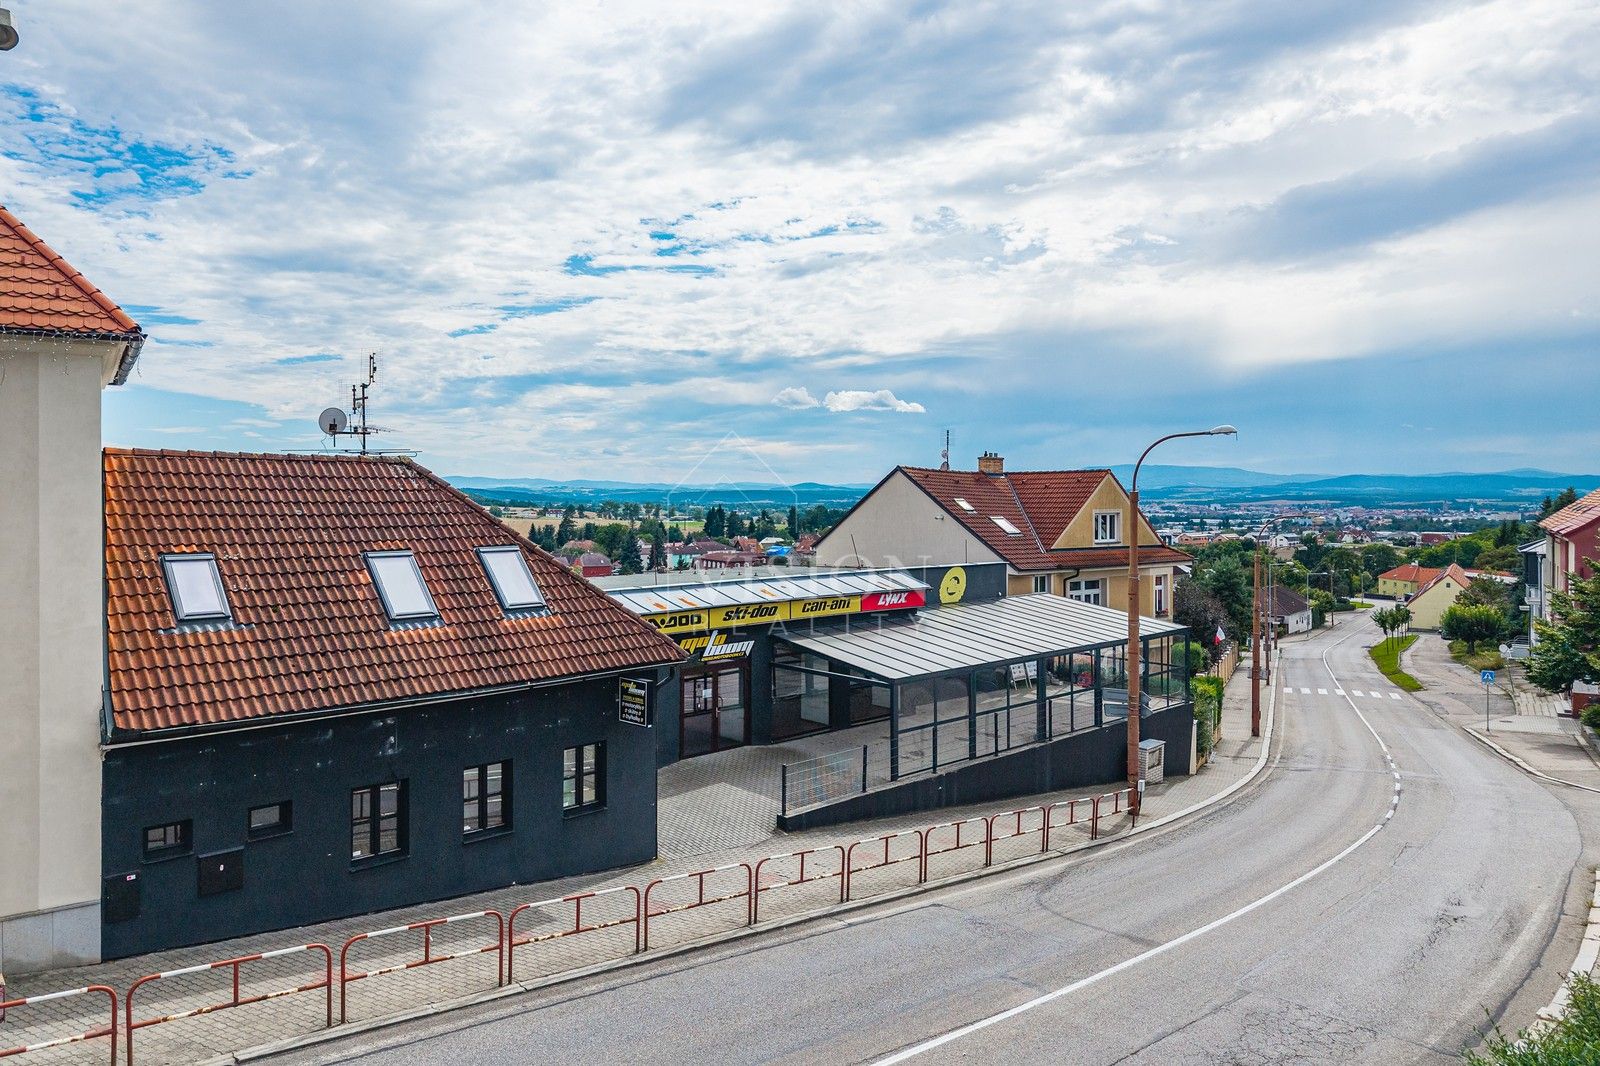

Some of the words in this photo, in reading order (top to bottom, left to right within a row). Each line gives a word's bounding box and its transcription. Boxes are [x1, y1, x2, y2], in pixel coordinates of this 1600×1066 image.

[801, 597, 851, 613] can-am
[877, 592, 909, 607] LYNX
[722, 604, 778, 622] ski-doo
[703, 632, 755, 657] boom
